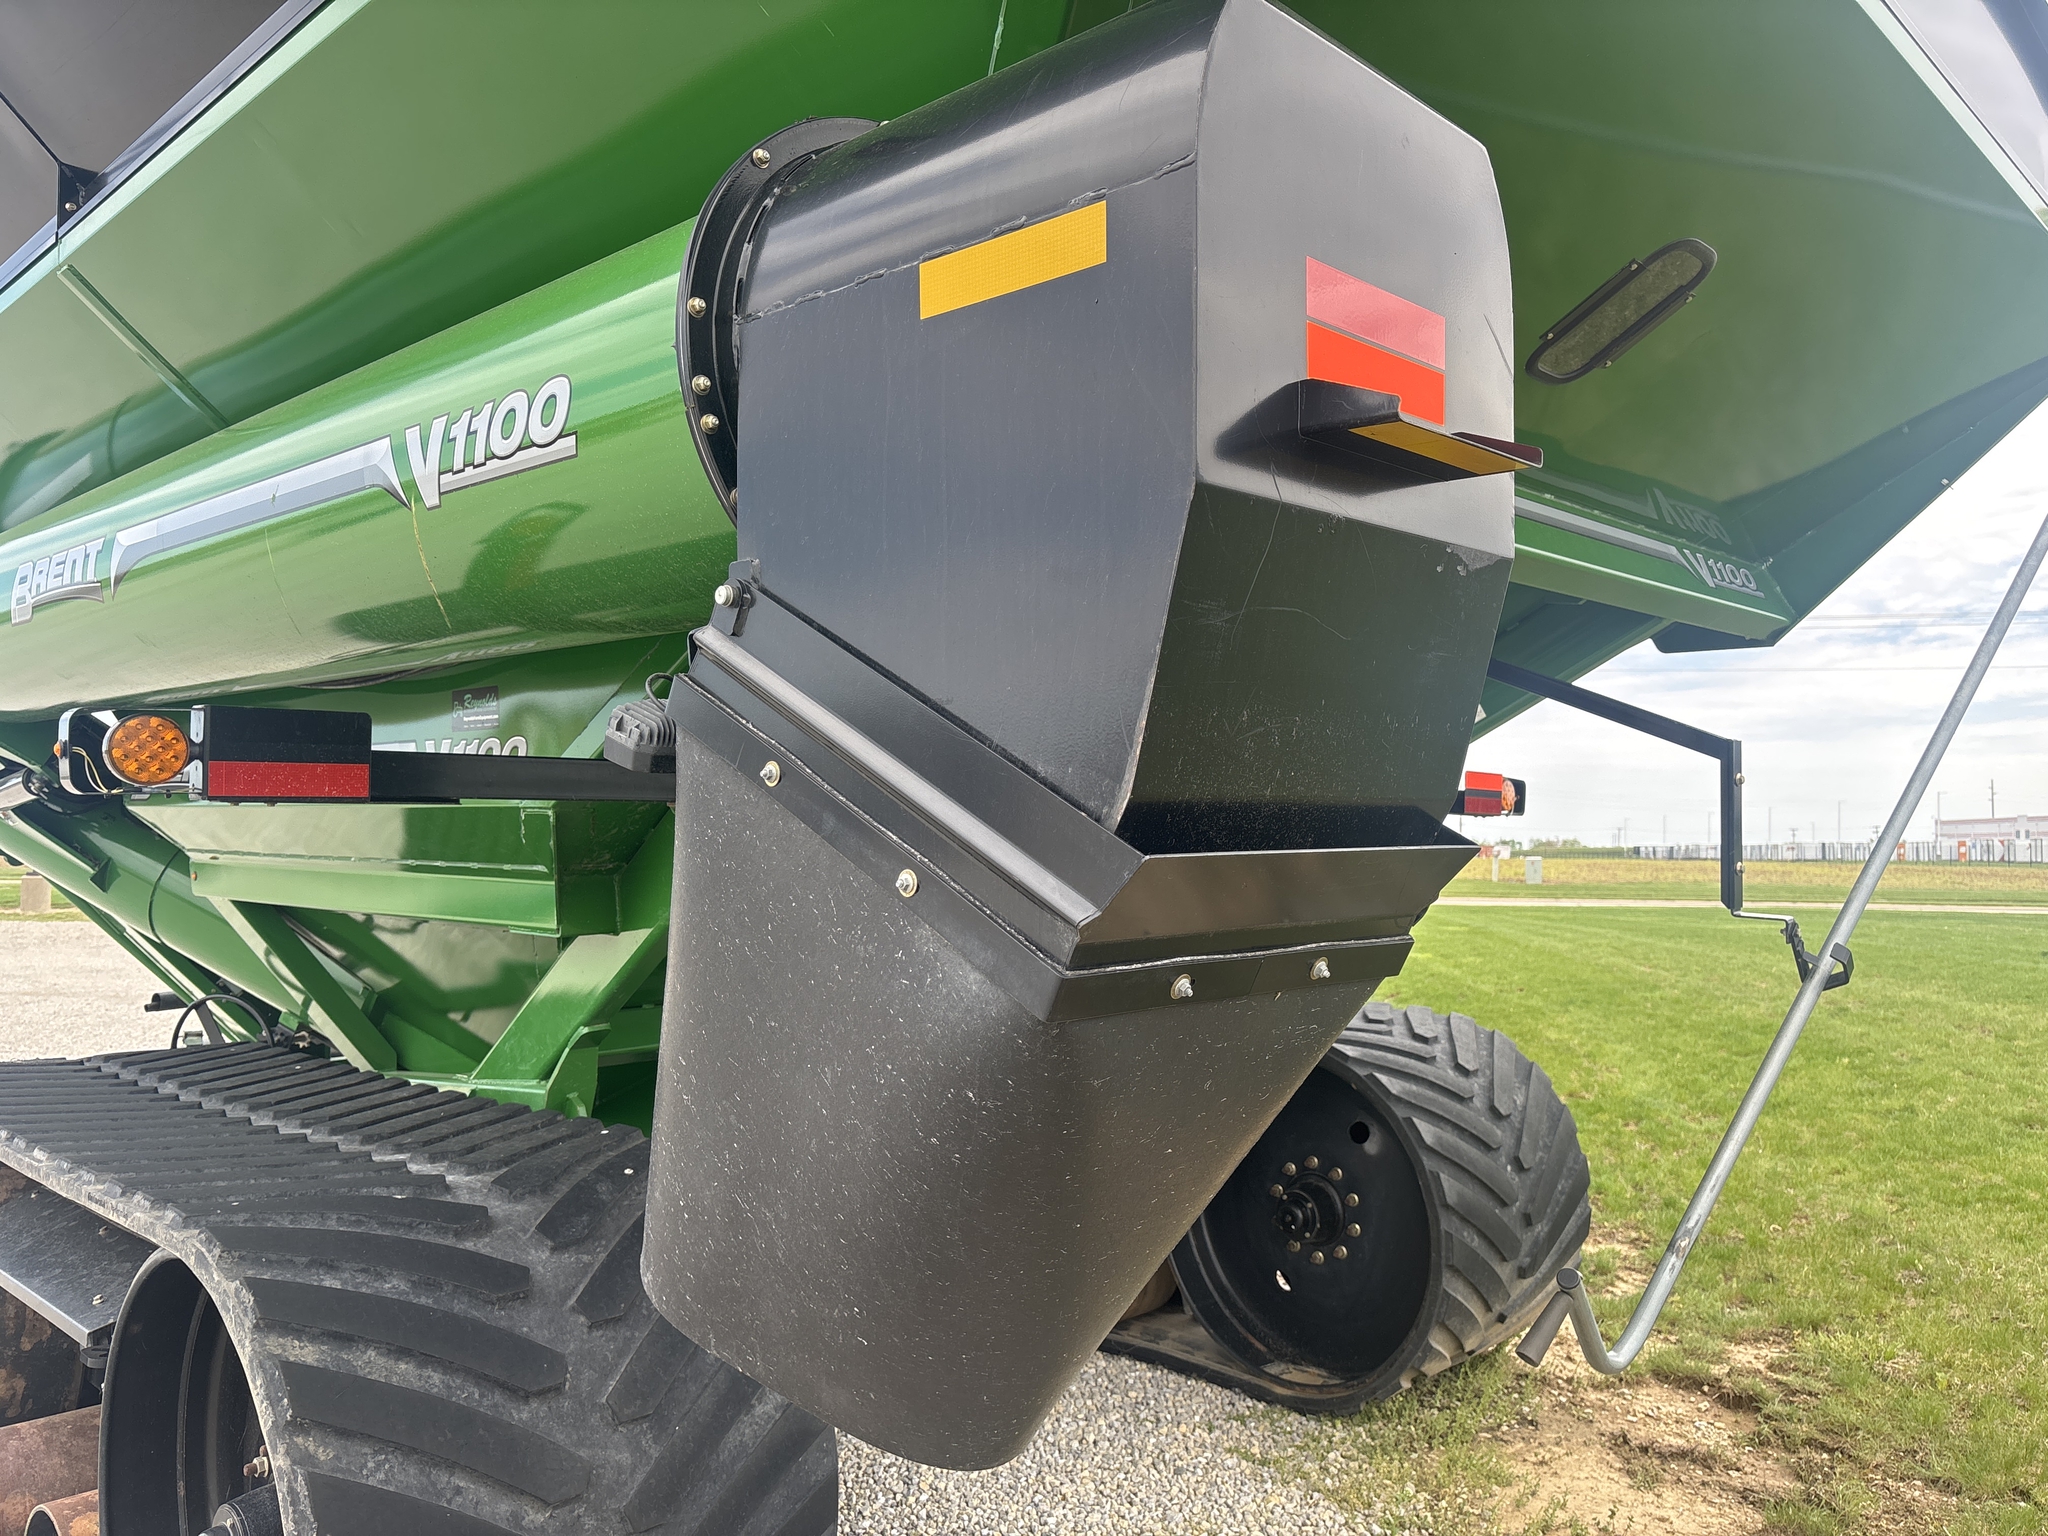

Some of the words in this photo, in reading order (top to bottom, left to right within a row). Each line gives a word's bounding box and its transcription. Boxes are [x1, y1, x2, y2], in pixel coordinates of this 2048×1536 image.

[404, 374, 572, 511] V1100
[11, 536, 106, 627] BRENT
[1682, 548, 1758, 591] V1100
[463, 693, 498, 710] Reynolds
